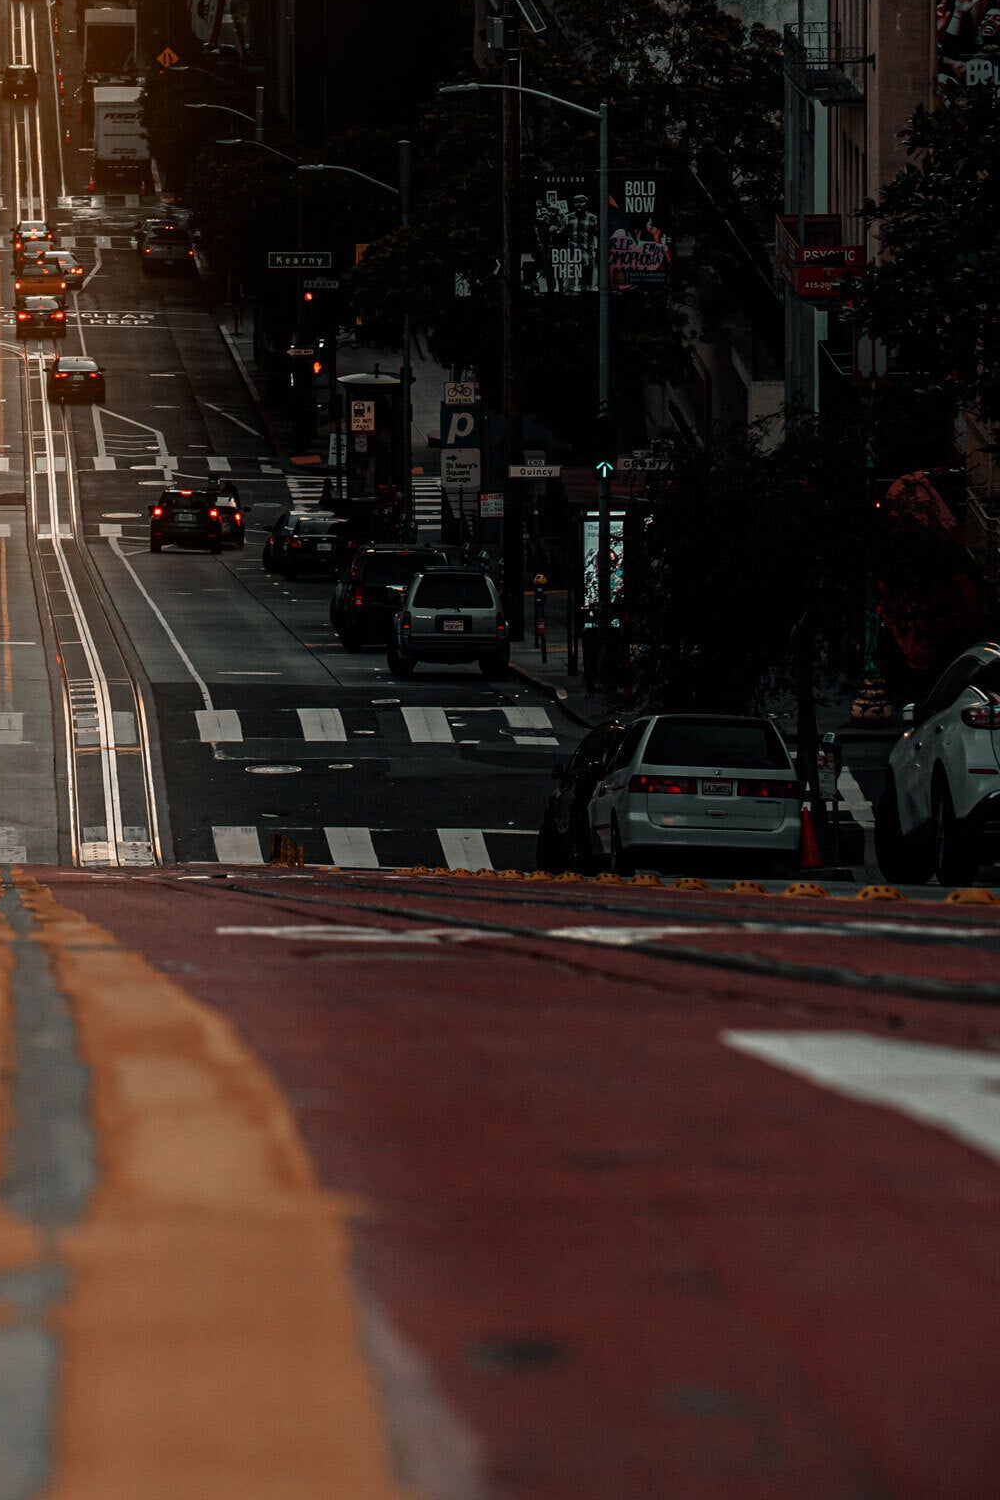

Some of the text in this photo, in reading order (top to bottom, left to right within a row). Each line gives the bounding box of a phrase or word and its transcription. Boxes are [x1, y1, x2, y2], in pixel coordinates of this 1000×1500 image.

[624, 180, 656, 196] BOLD
[624, 196, 656, 213] NOW
[275, 256, 323, 266] Kearny
[551, 248, 582, 263] BOLD
[551, 263, 582, 279] THEN
[520, 467, 553, 477] Quincy
